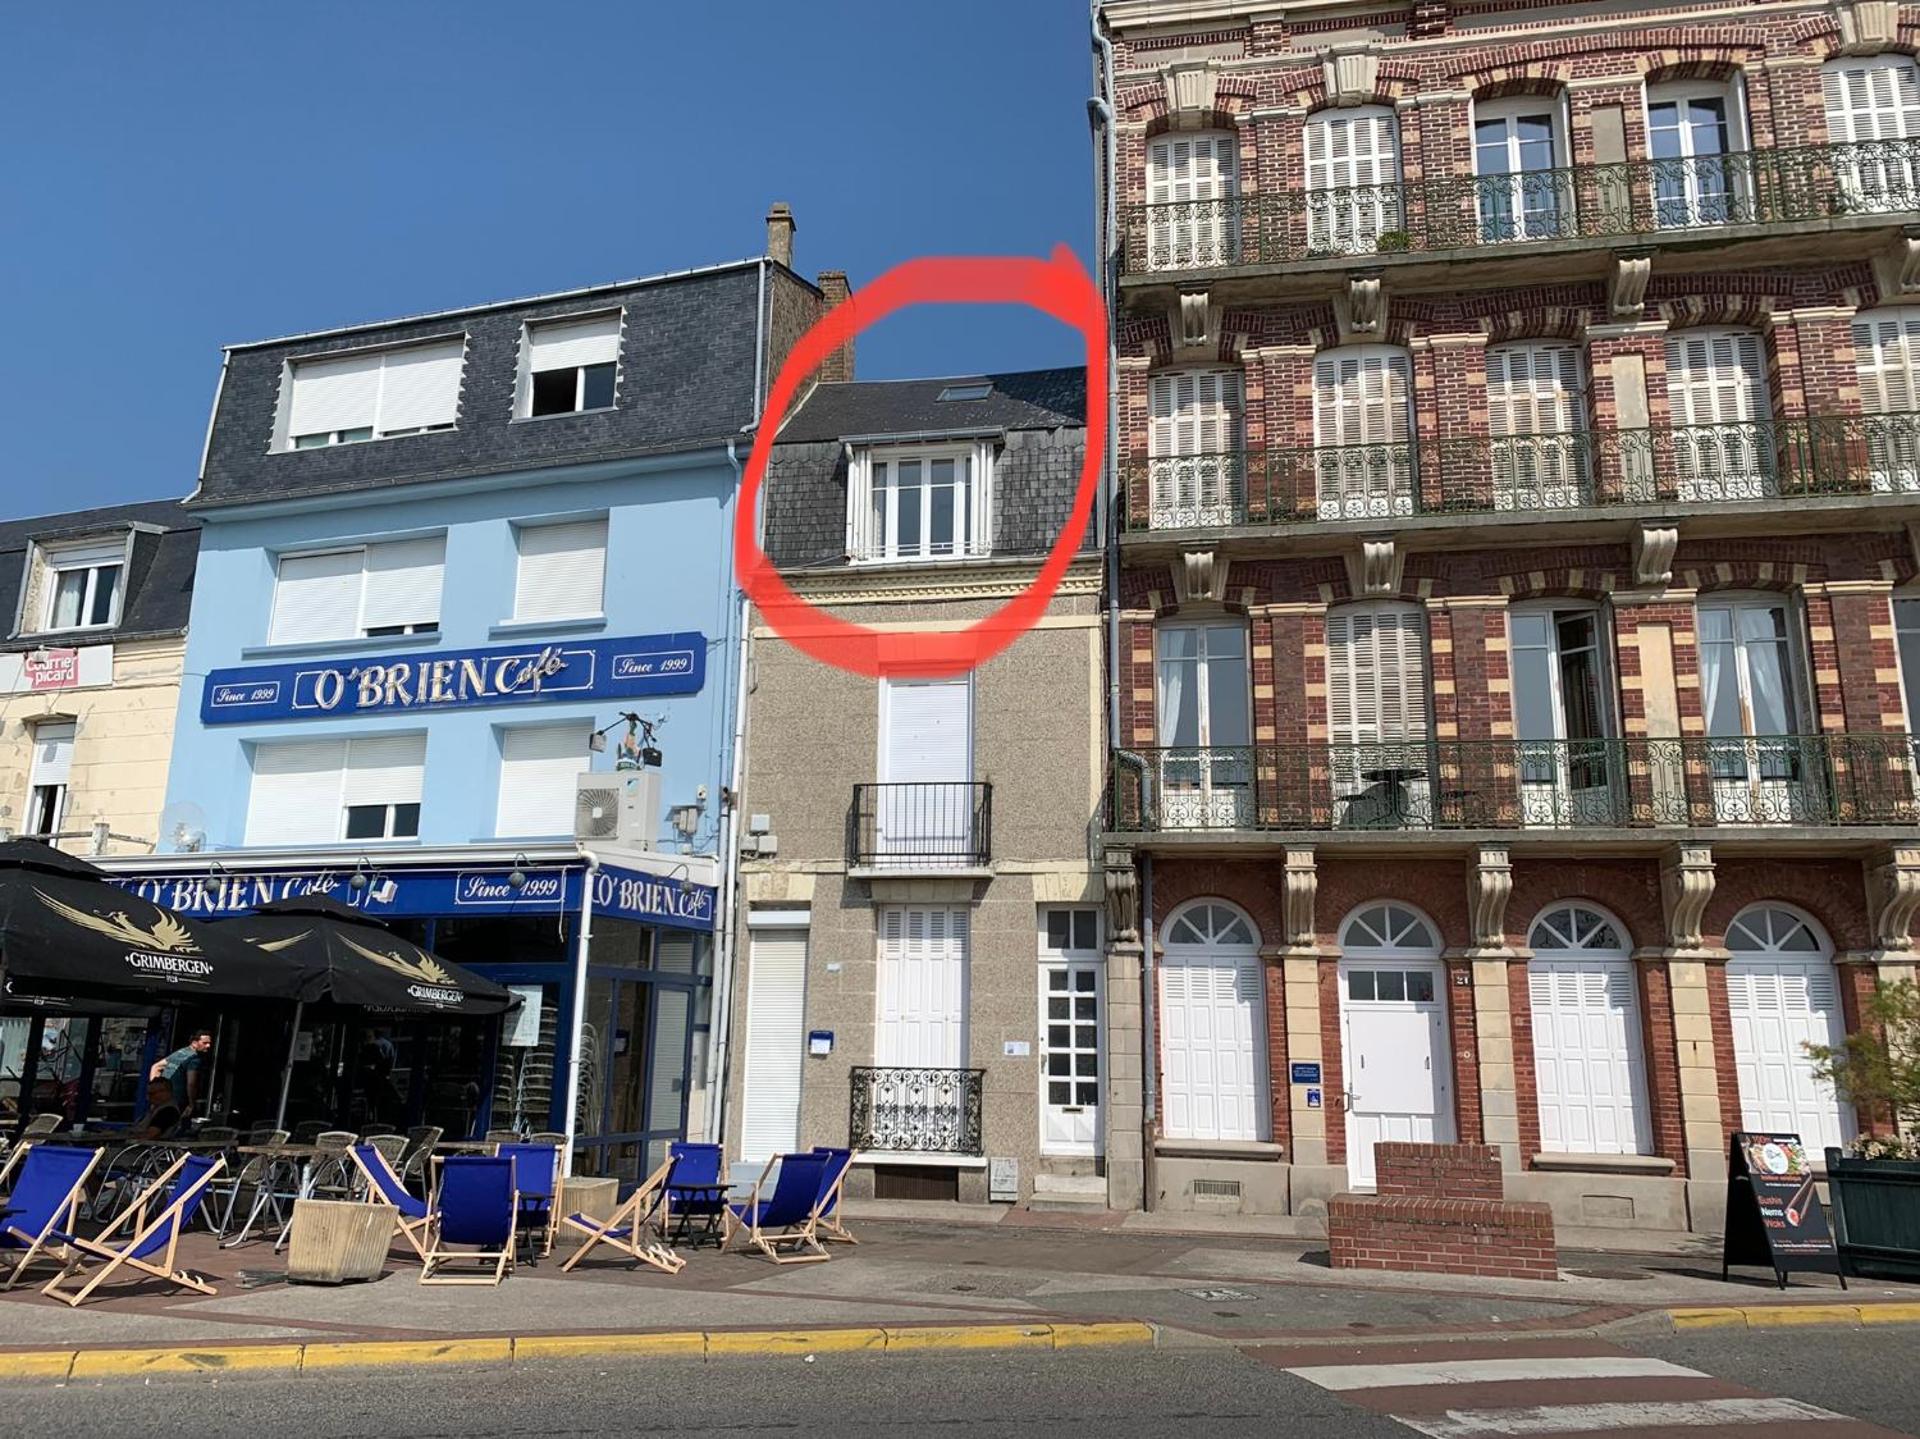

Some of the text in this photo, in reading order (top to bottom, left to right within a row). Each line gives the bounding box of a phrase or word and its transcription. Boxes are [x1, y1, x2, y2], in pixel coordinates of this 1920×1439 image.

[618, 658, 688, 674] Since 1999
[35, 668, 74, 686] picard
[315, 646, 569, 710] O'BRIEN Café
[216, 688, 275, 703] Since 1999
[138, 876, 274, 913] O'BRIEN
[464, 876, 559, 898] Since 1999
[598, 874, 676, 916] O'BRIEN
[129, 952, 210, 974] GRIMBERGEN
[410, 984, 463, 1002] GRIMBERGEN
[1760, 1207, 1784, 1217] Nems
